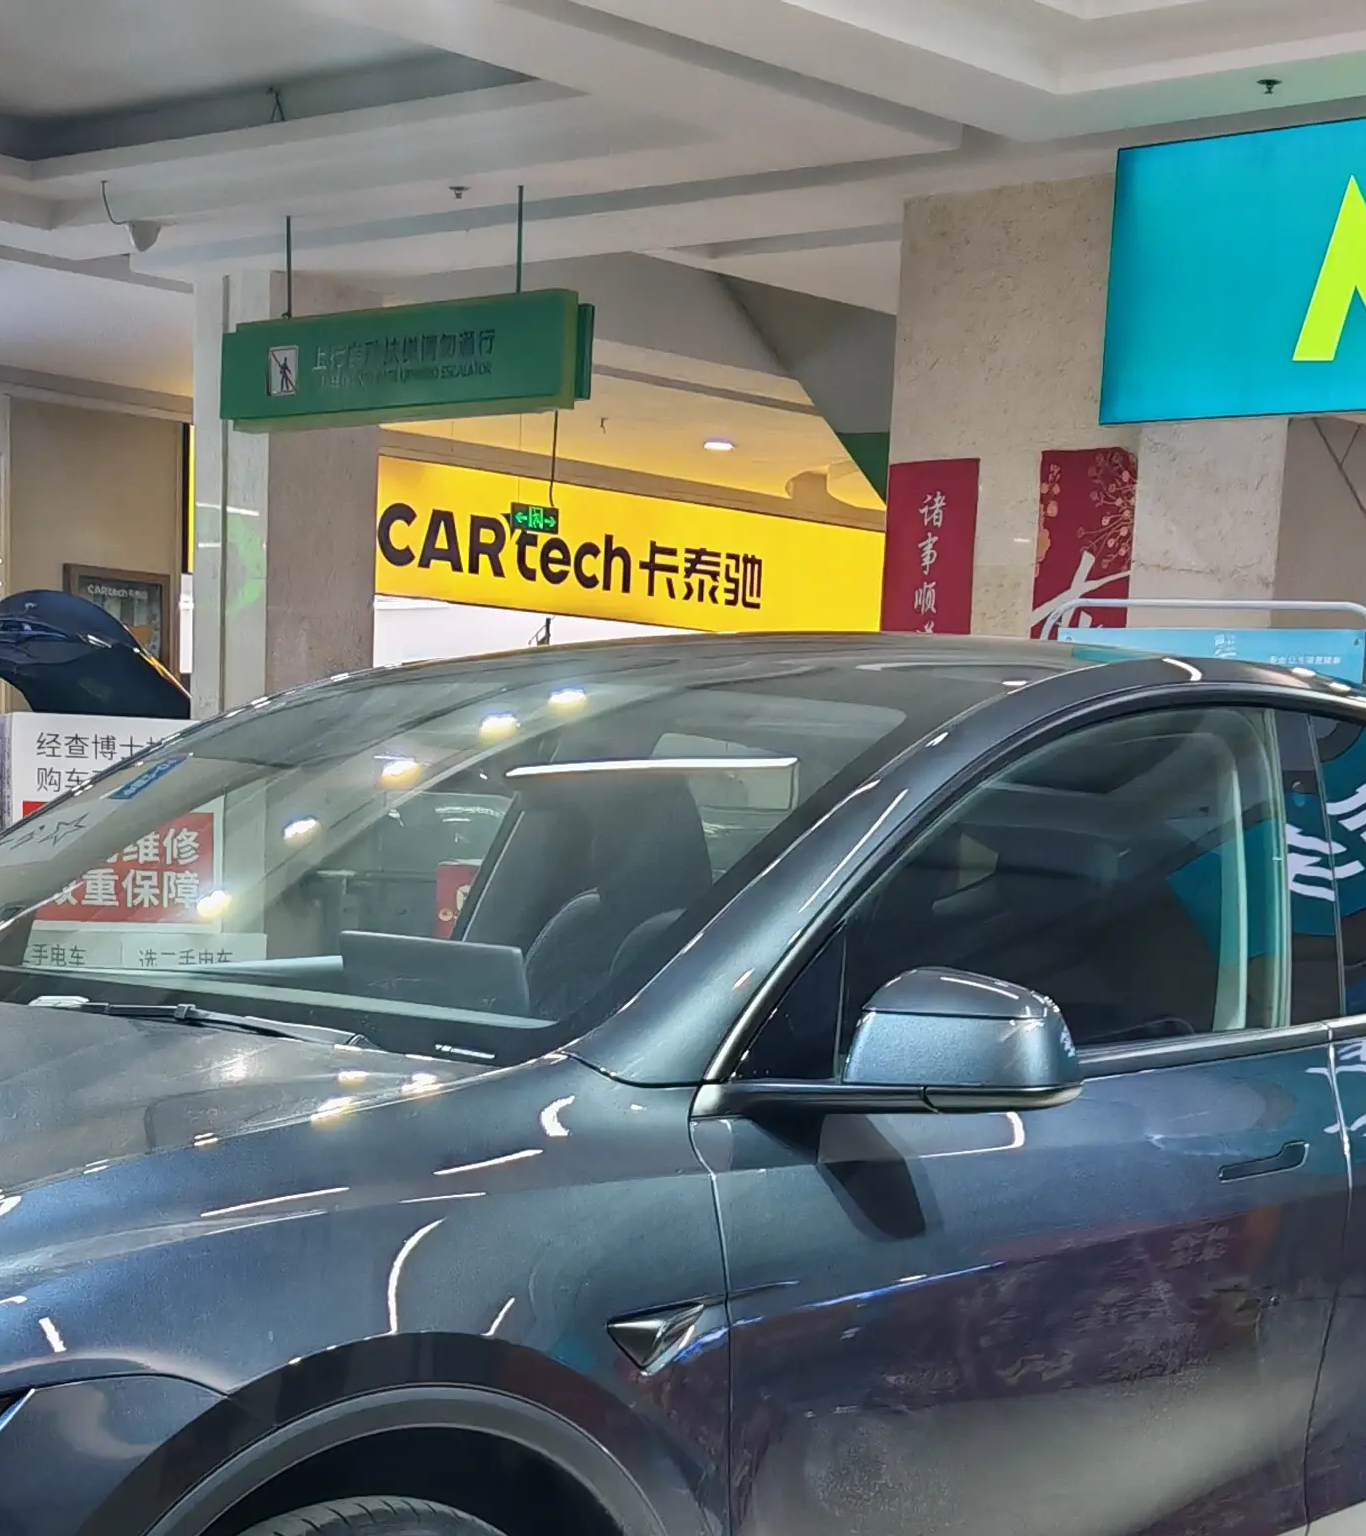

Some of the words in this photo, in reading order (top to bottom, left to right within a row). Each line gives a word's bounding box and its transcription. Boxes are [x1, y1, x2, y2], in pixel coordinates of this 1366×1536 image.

[638, 540, 763, 610] 卡泰驰
[36, 767, 105, 793] 购车
[107, 828, 200, 866] 维修
